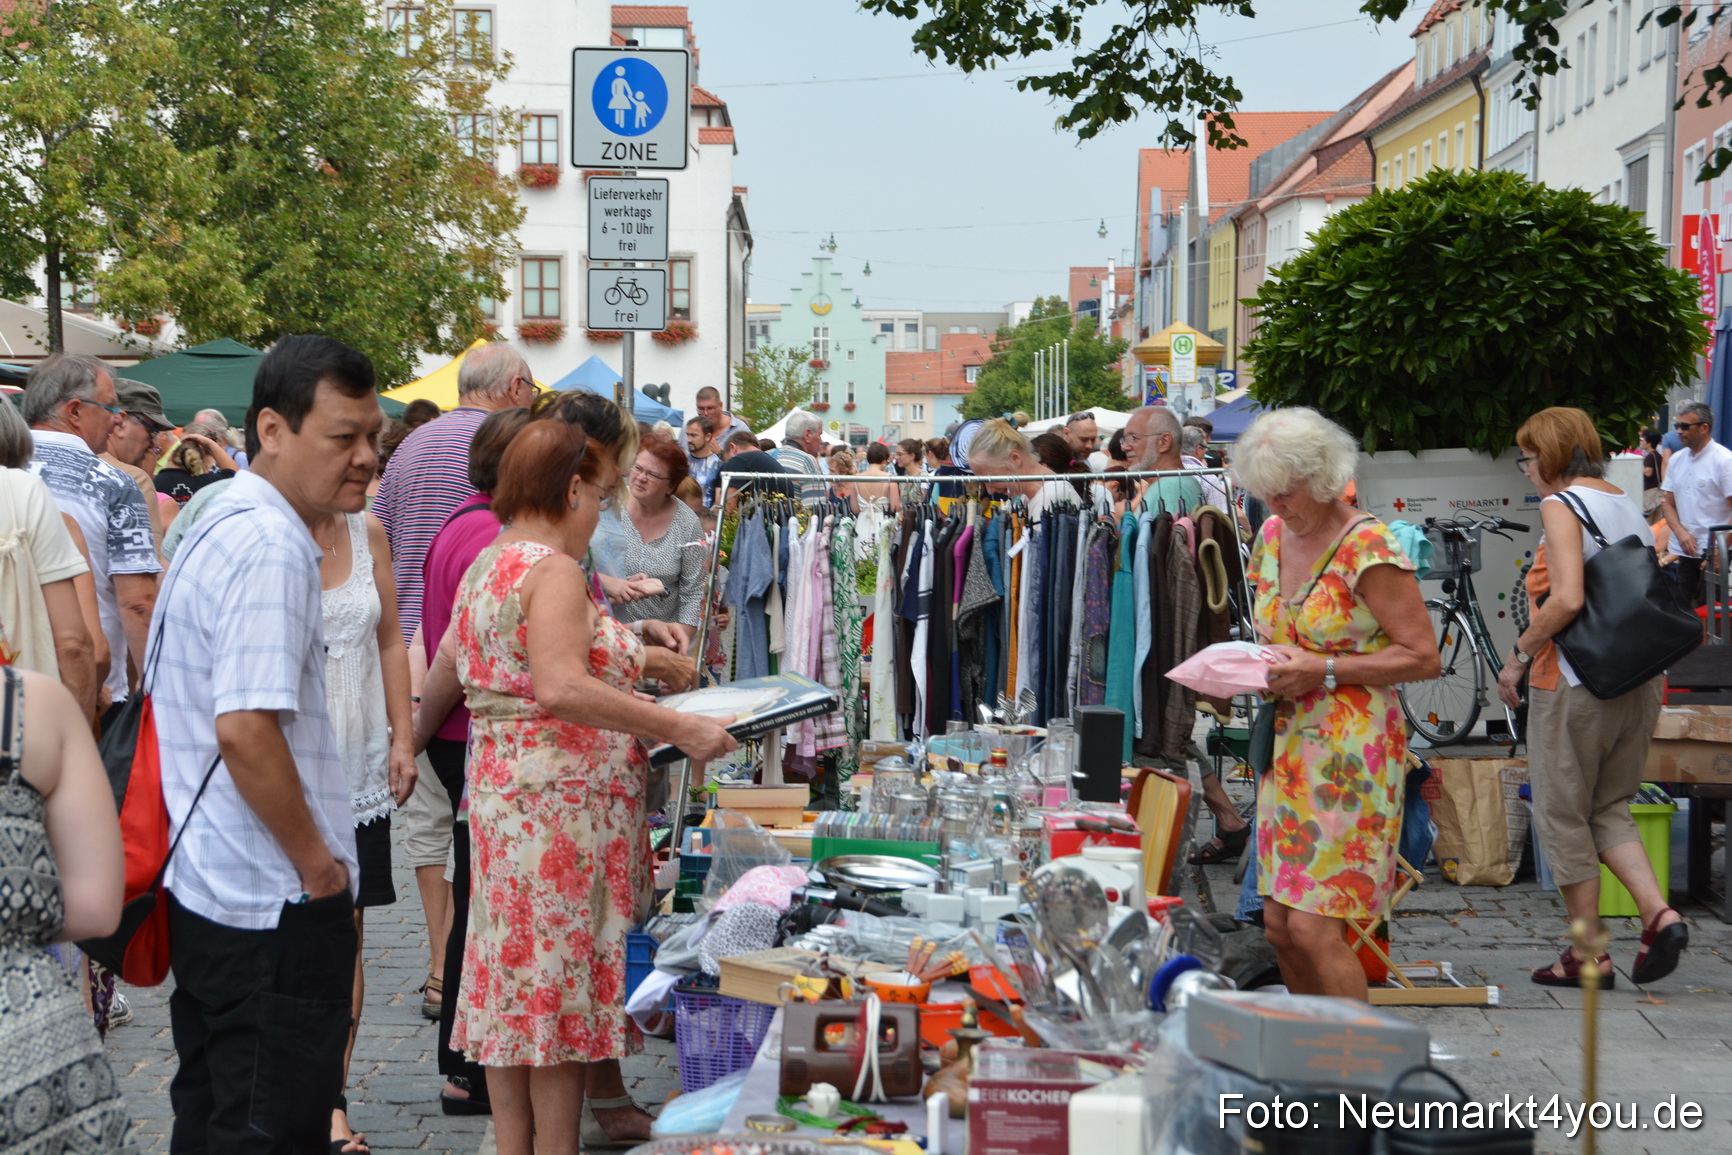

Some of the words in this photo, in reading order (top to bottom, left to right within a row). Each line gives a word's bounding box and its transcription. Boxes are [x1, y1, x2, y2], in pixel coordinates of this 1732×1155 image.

[601, 142, 658, 161] ZONE
[594, 188, 664, 202] Lieferverkehr
[604, 206, 652, 220] werktags
[602, 223, 608, 235] 6
[621, 223, 633, 235] 10
[636, 223, 654, 235] Uhr
[618, 240, 637, 252] frei
[614, 310, 639, 323] frei
[1449, 498, 1500, 508] NEUMARKT
[774, 709, 807, 724] STANDARD
[981, 1088, 1071, 1105] EIERKOCHER
